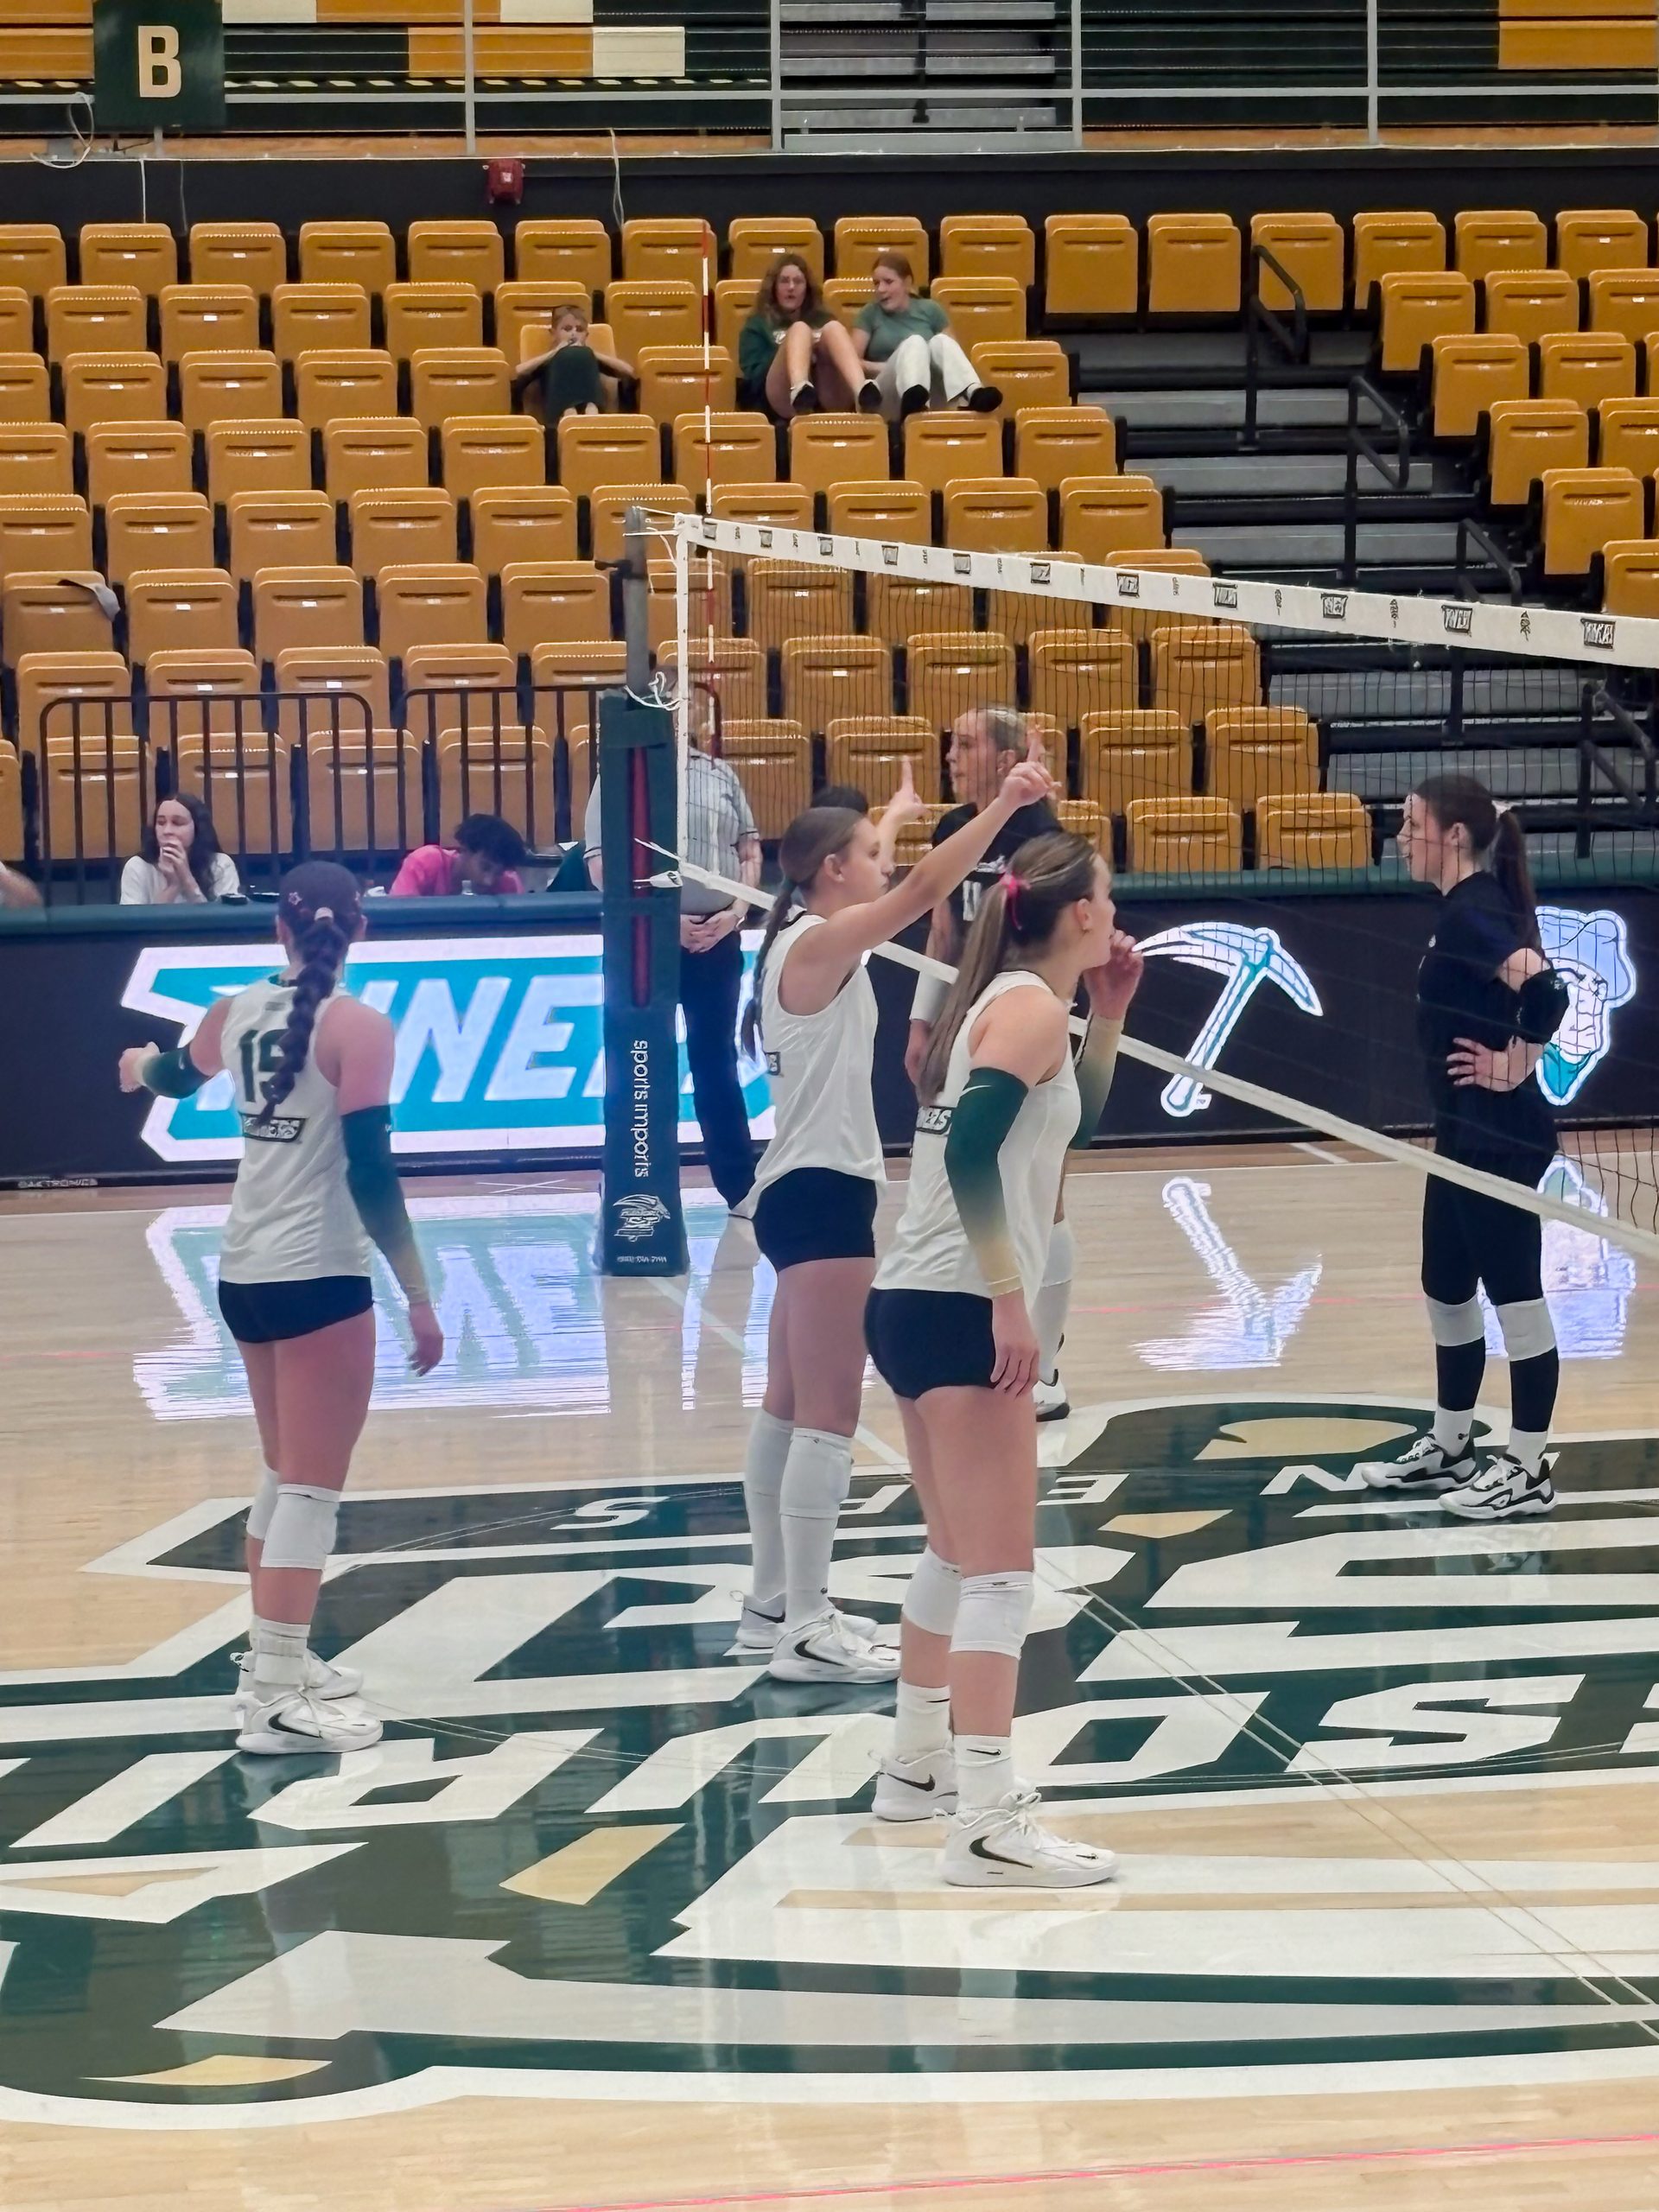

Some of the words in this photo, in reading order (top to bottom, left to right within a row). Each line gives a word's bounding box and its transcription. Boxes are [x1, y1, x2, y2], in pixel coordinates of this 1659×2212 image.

[138, 25, 181, 97] B
[631, 1039, 650, 1100] sports
[631, 1103, 652, 1178] imports
